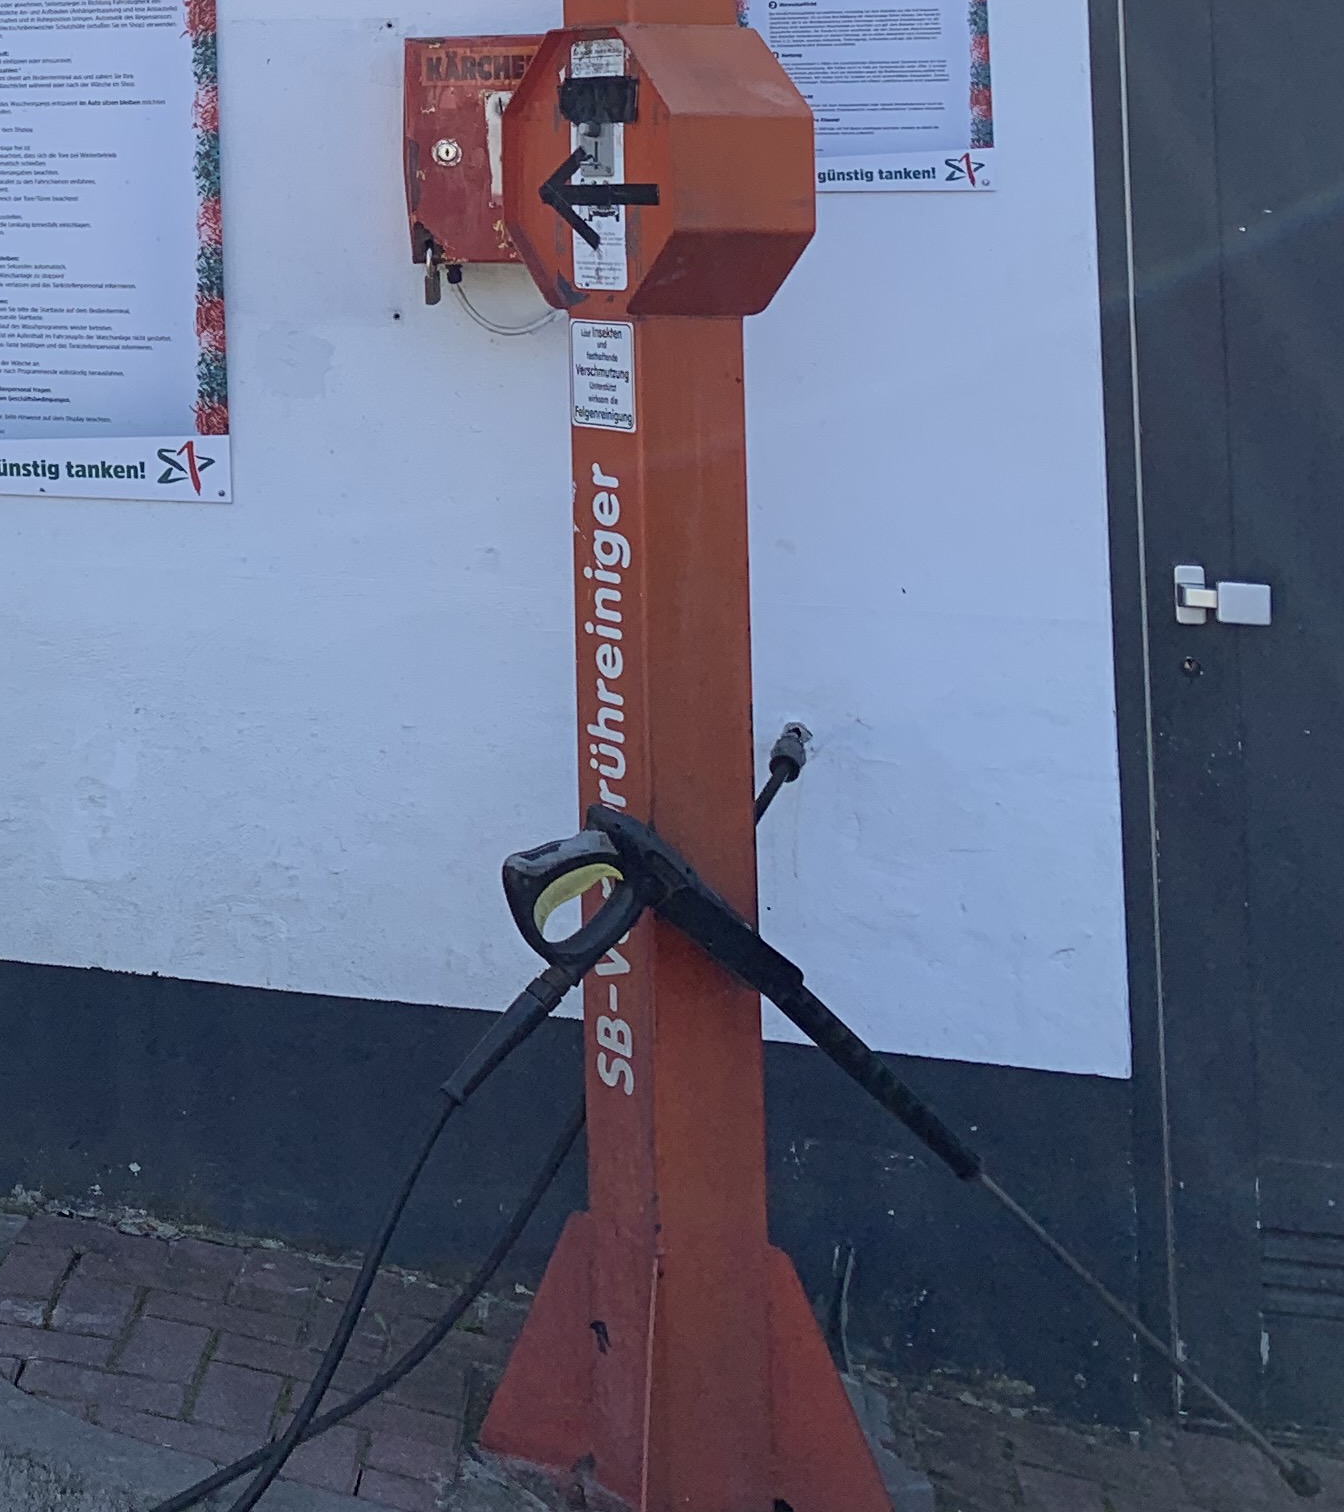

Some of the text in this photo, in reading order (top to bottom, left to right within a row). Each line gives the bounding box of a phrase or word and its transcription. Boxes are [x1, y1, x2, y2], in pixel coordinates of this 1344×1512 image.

[426, 50, 533, 82] KÄRCHE
[817, 167, 937, 183] günstig tanken!
[592, 327, 622, 339] Insekten
[597, 341, 607, 349] und
[575, 363, 630, 384] Verschmutzung
[575, 405, 632, 426] Felgenreinigung
[65, 460, 146, 480] tanken!
[584, 463, 633, 1095] SB-Vrühreiniger
